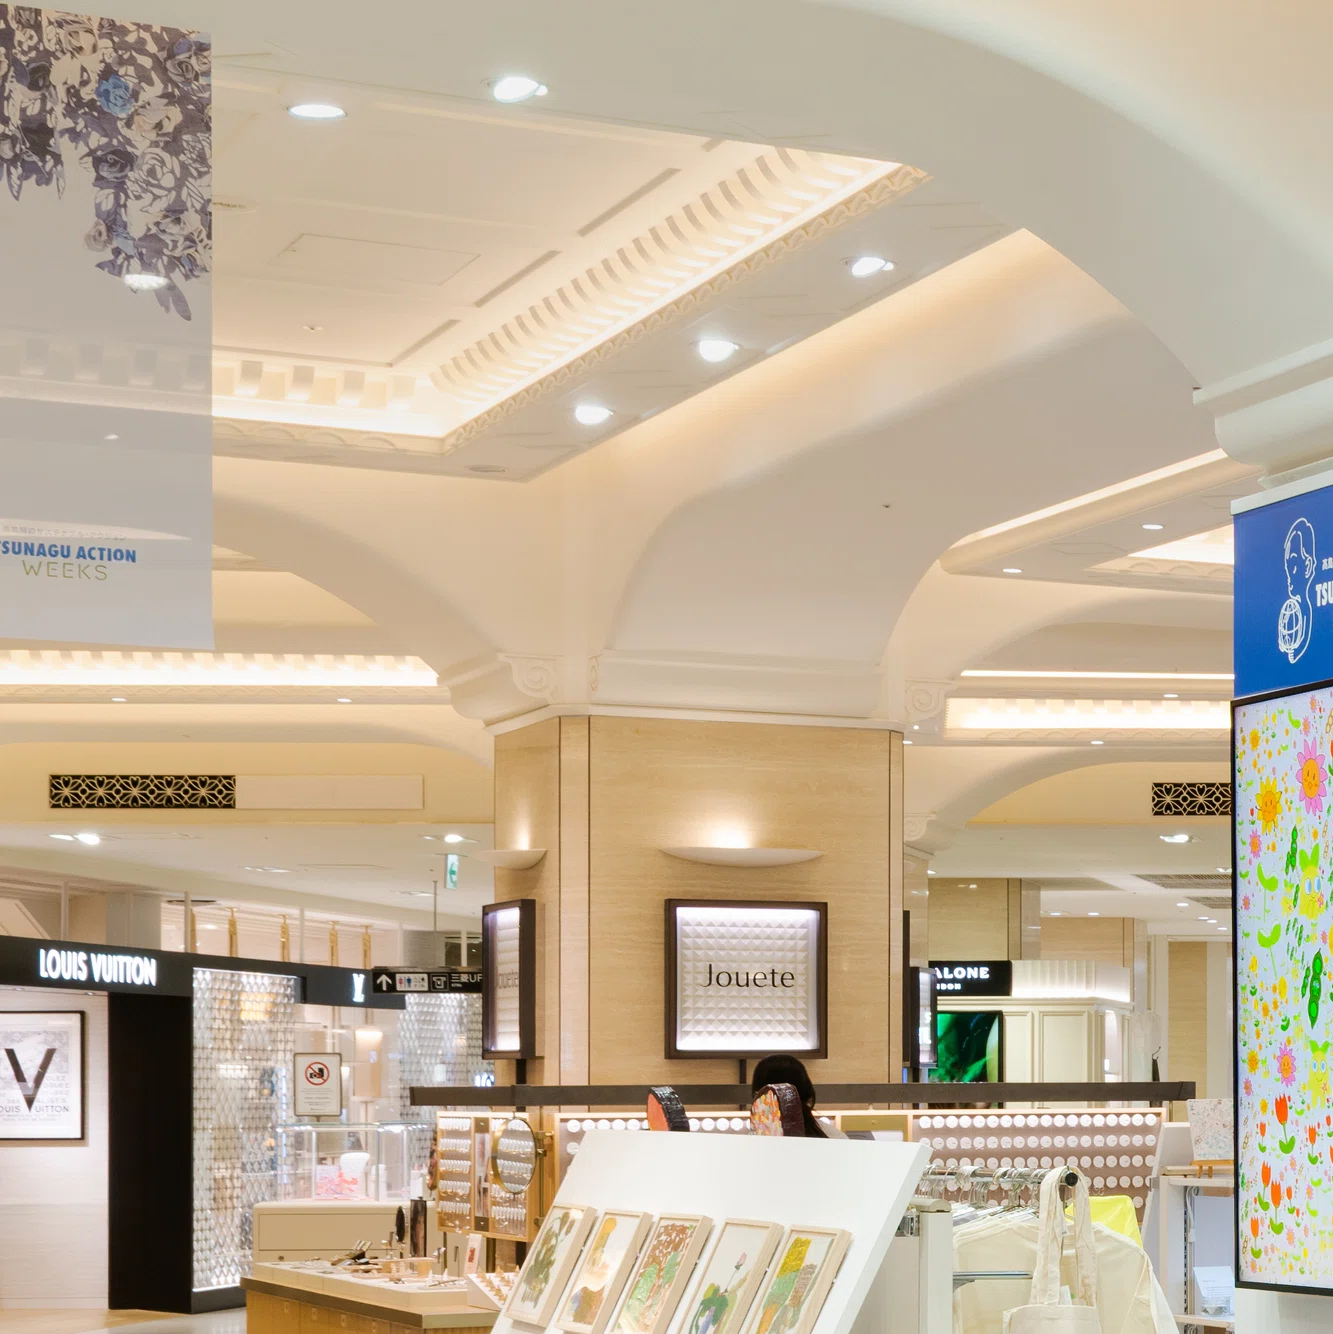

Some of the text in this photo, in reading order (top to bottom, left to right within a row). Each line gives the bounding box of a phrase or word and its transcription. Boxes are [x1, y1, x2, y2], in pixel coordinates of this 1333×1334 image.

[0, 540, 137, 564] SUNAGU ACTION
[22, 559, 108, 581] WEEKS
[38, 948, 157, 987] LOUIS VUITTON
[699, 963, 795, 988] Jouete
[934, 966, 990, 979] ALONE
